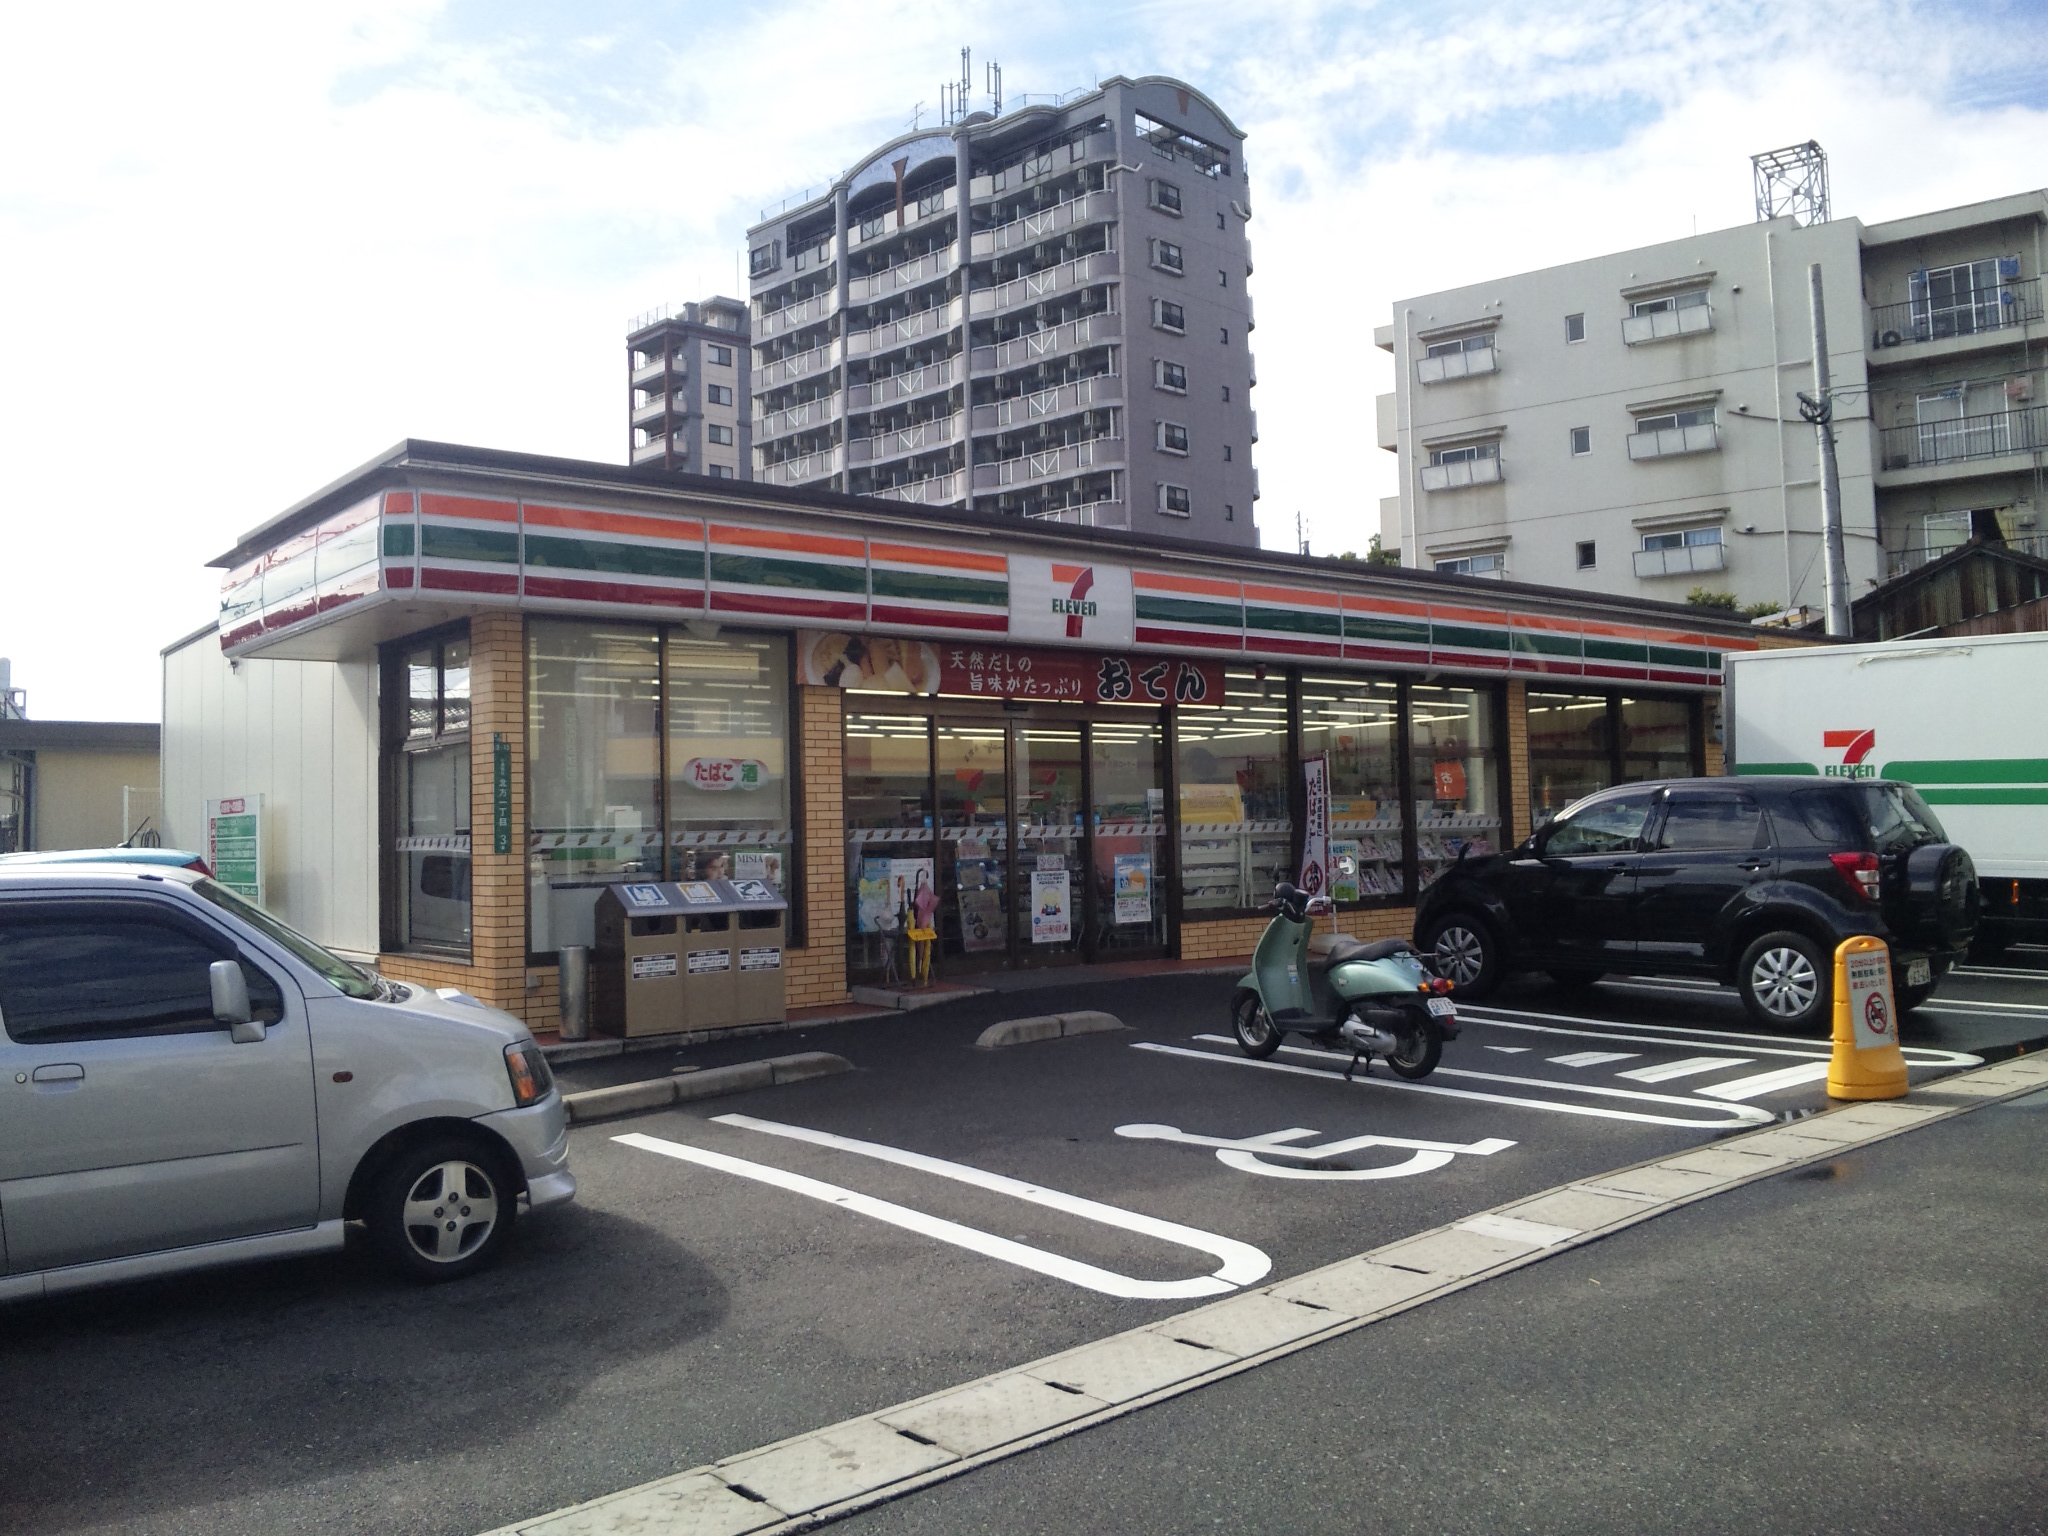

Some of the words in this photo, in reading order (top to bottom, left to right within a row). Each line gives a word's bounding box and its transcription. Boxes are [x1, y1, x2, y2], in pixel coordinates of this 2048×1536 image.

[950, 650, 1032, 673] 天然だしの
[969, 672, 1081, 696] 旨味がたっぷり
[1097, 657, 1207, 702] おでん
[1824, 729, 1875, 764] 7
[695, 762, 734, 782] たばこ
[741, 763, 758, 783] 酒
[498, 779, 507, 827] 北方一丁目
[737, 854, 764, 864] MISIA
